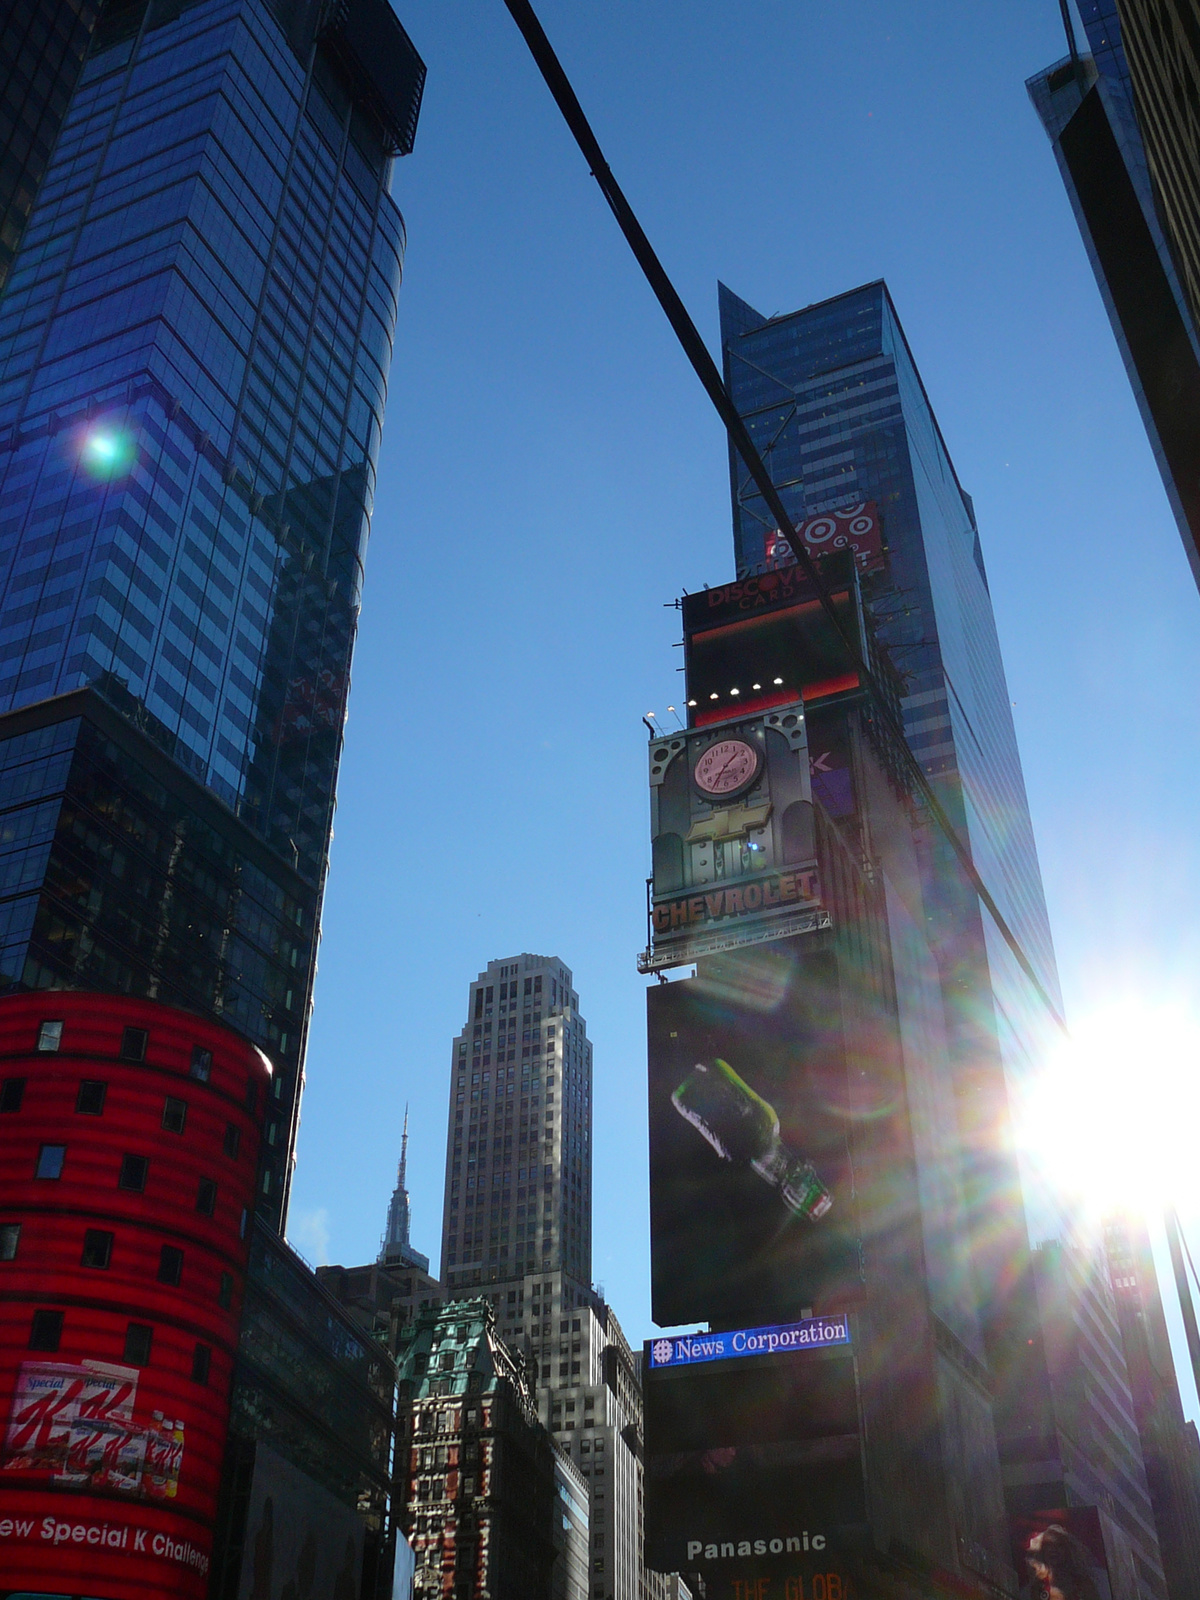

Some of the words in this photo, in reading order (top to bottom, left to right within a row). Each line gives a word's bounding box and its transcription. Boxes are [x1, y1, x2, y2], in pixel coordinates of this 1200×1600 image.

[739, 586, 794, 610] CARD
[704, 758, 713, 766] 10
[720, 745, 729, 753] 12
[652, 871, 817, 929] CHEVROLET
[675, 1338, 725, 1360] News
[732, 1321, 847, 1353] Corporation
[26, 1377, 65, 1391] Special
[85, 1377, 117, 1390] pecial
[12, 1379, 85, 1451] K
[40, 1516, 129, 1546] Special
[134, 1528, 149, 1552] K
[152, 1533, 210, 1577] Challenge
[686, 1531, 827, 1561] Panasonic
